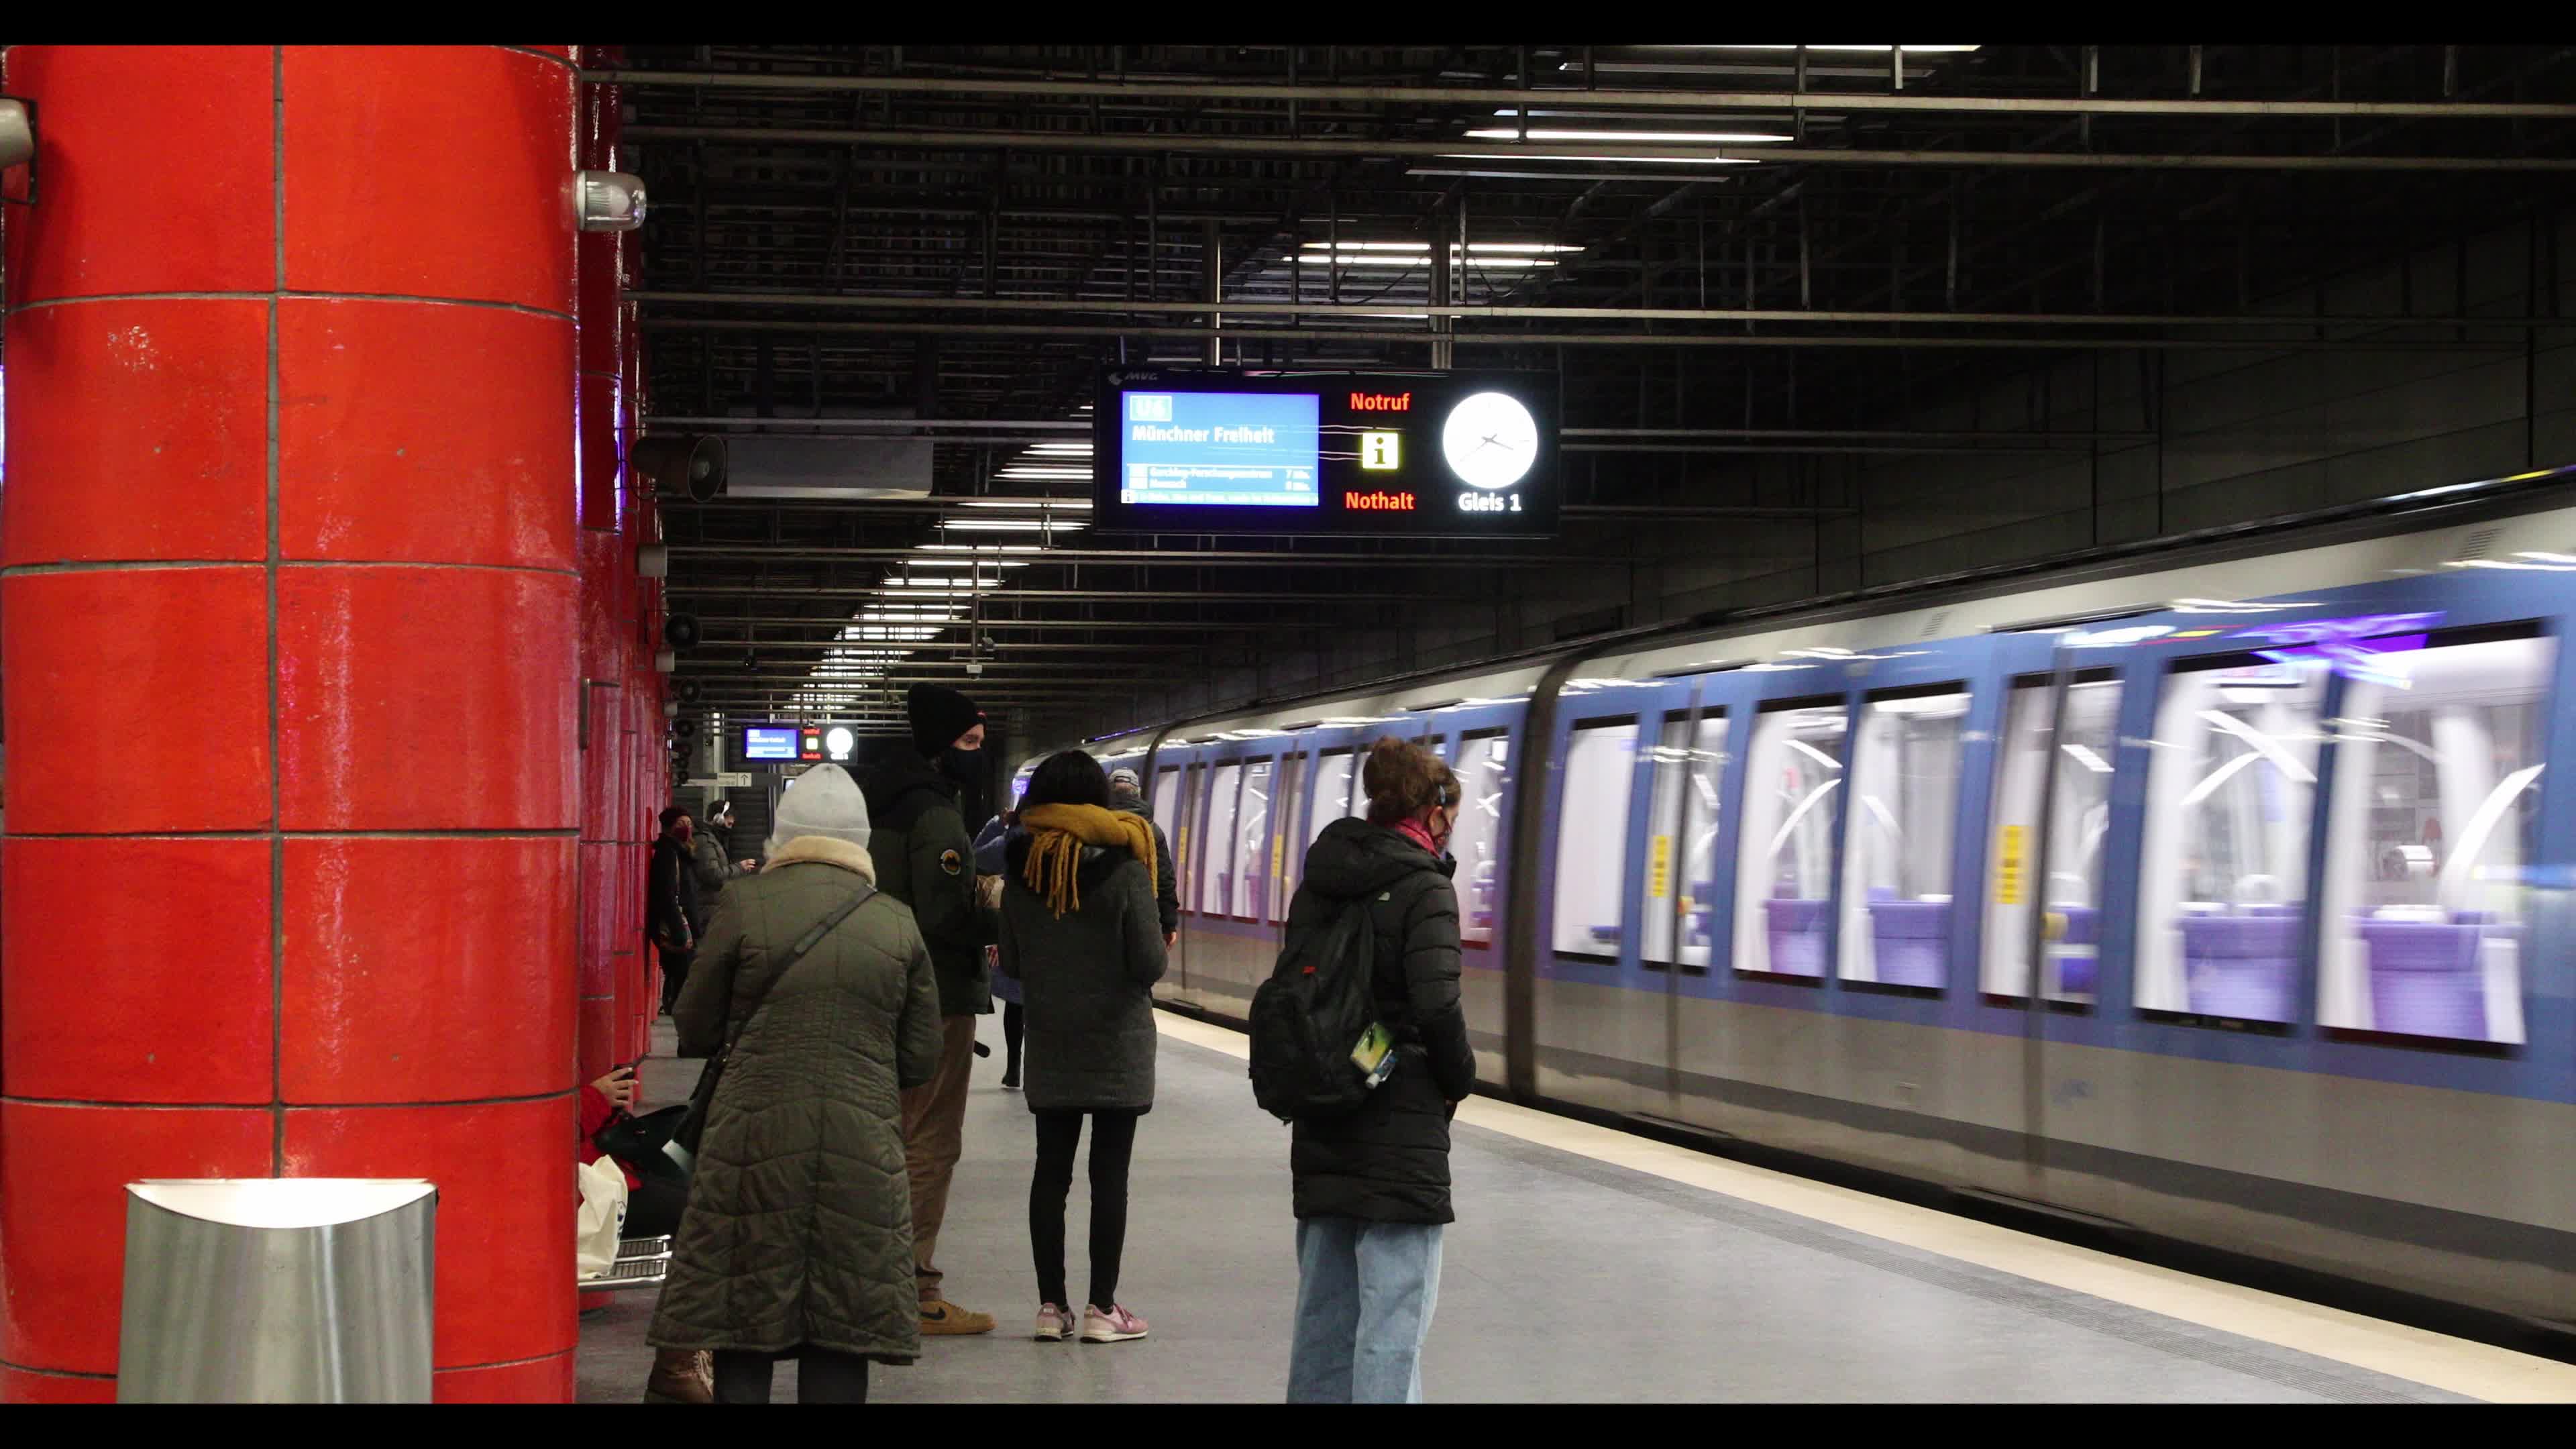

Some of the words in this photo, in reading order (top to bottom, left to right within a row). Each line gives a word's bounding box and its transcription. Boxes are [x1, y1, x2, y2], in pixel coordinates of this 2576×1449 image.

[1350, 393, 1409, 410] Notruf
[1132, 425, 1210, 442] Münchner
[1214, 425, 1275, 443] Freiheit
[1346, 491, 1414, 510] Nothalt
[1458, 492, 1505, 512] Gleis
[1509, 493, 1522, 512] 1
